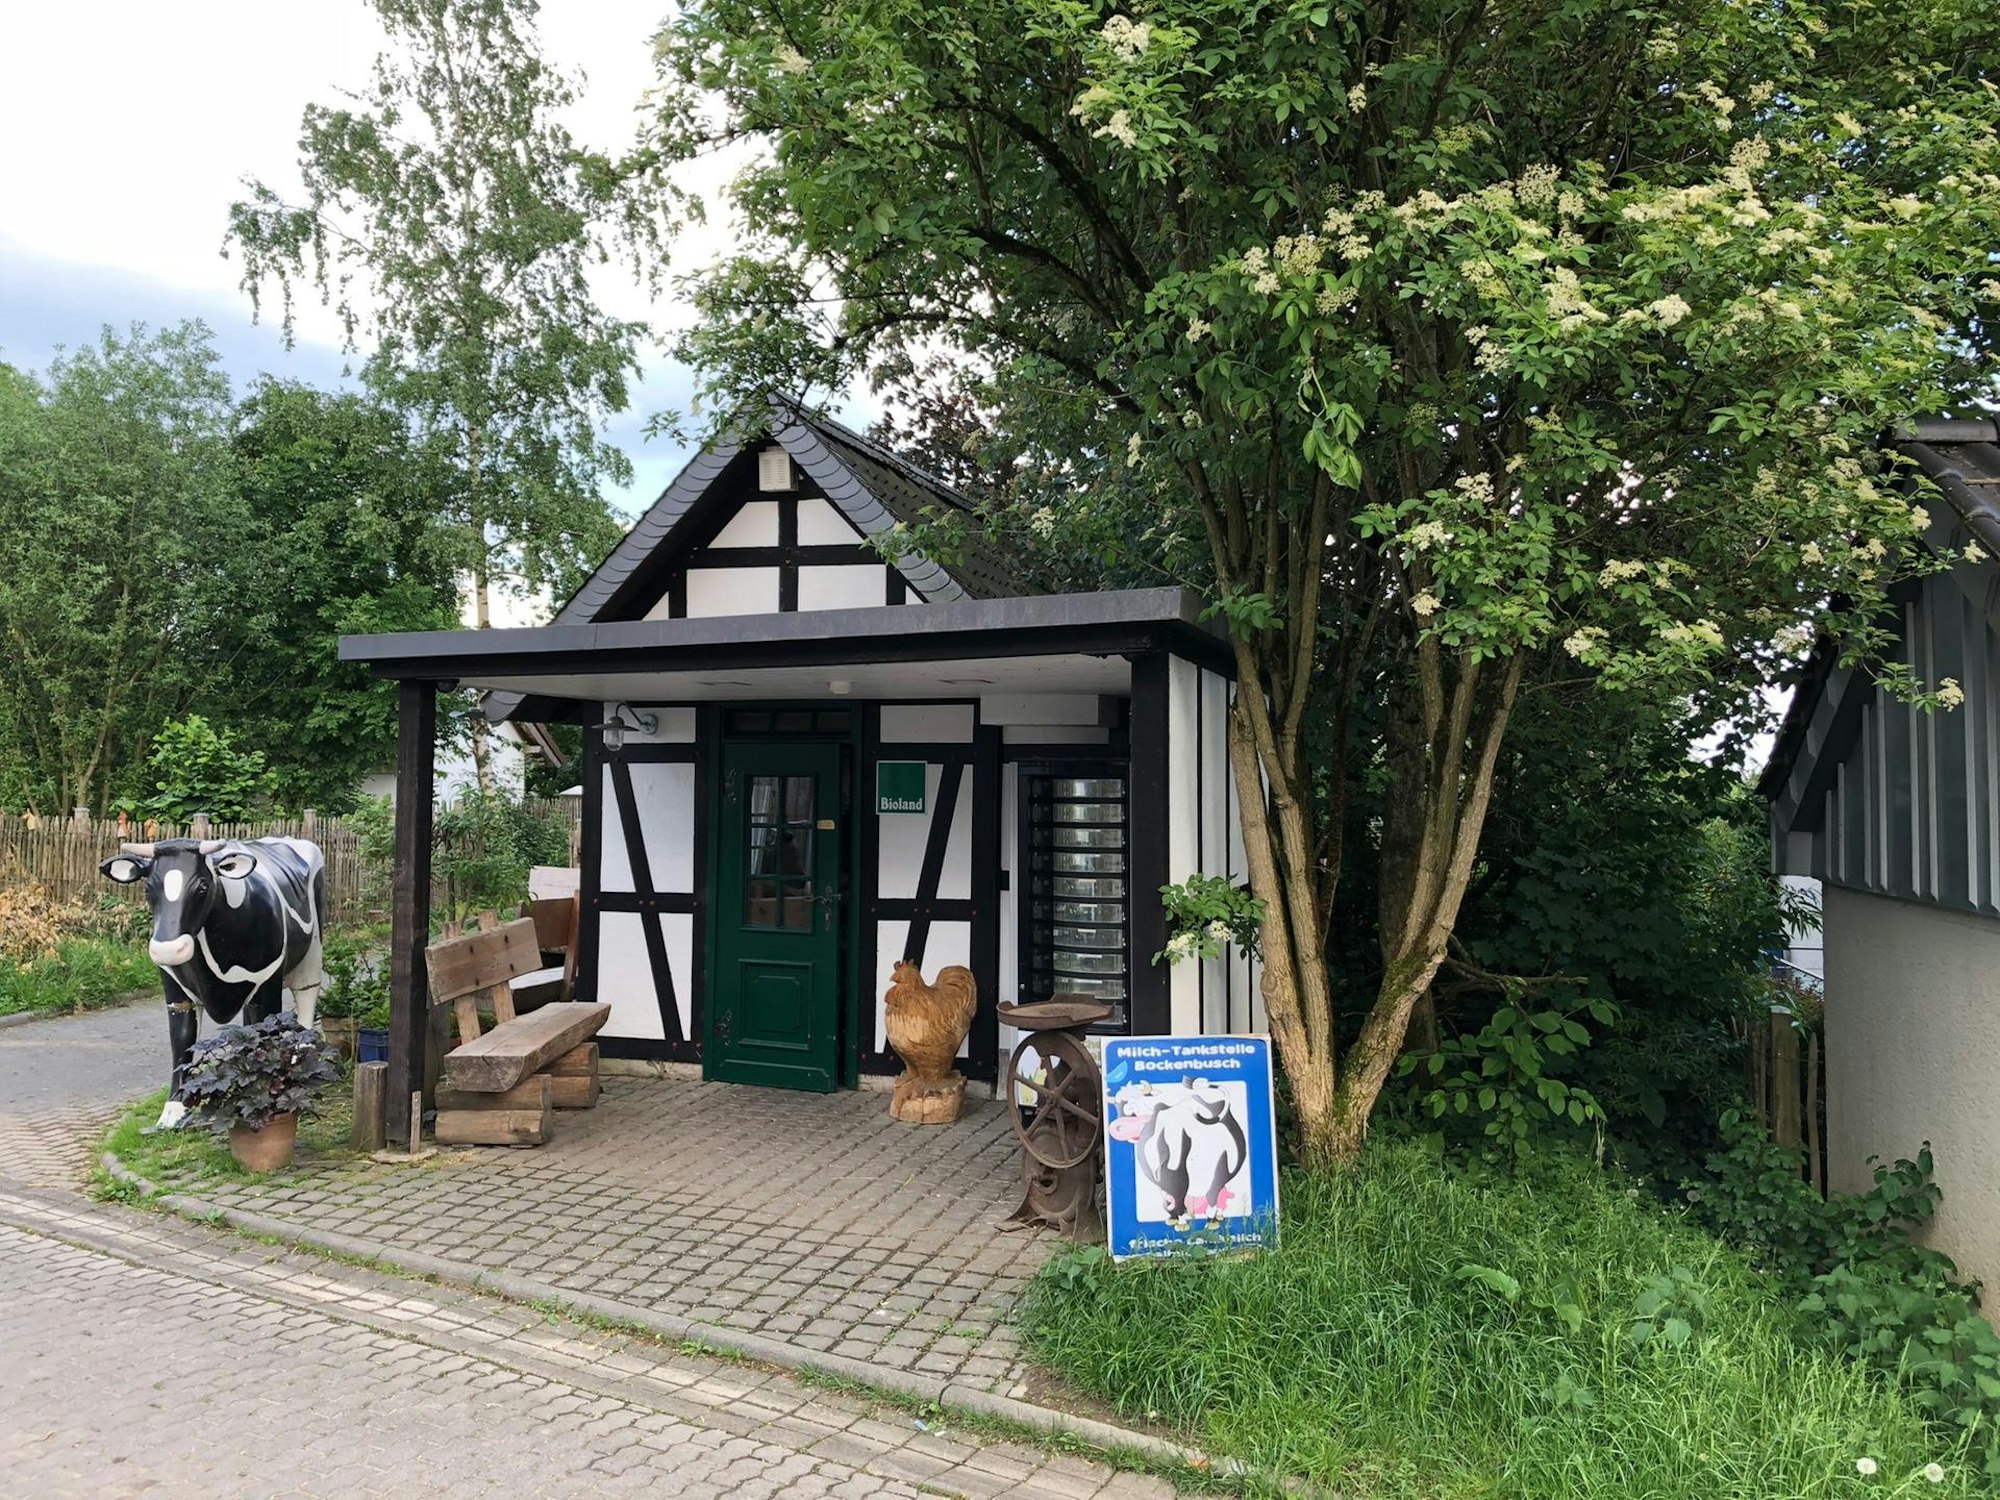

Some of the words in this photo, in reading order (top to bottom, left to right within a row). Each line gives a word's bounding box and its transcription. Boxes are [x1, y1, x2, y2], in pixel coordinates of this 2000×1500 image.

[880, 796, 923, 810] Bioland
[1117, 1044, 1256, 1058] Milch-Tankstelle
[1134, 1058, 1241, 1071] Bockenbusch
